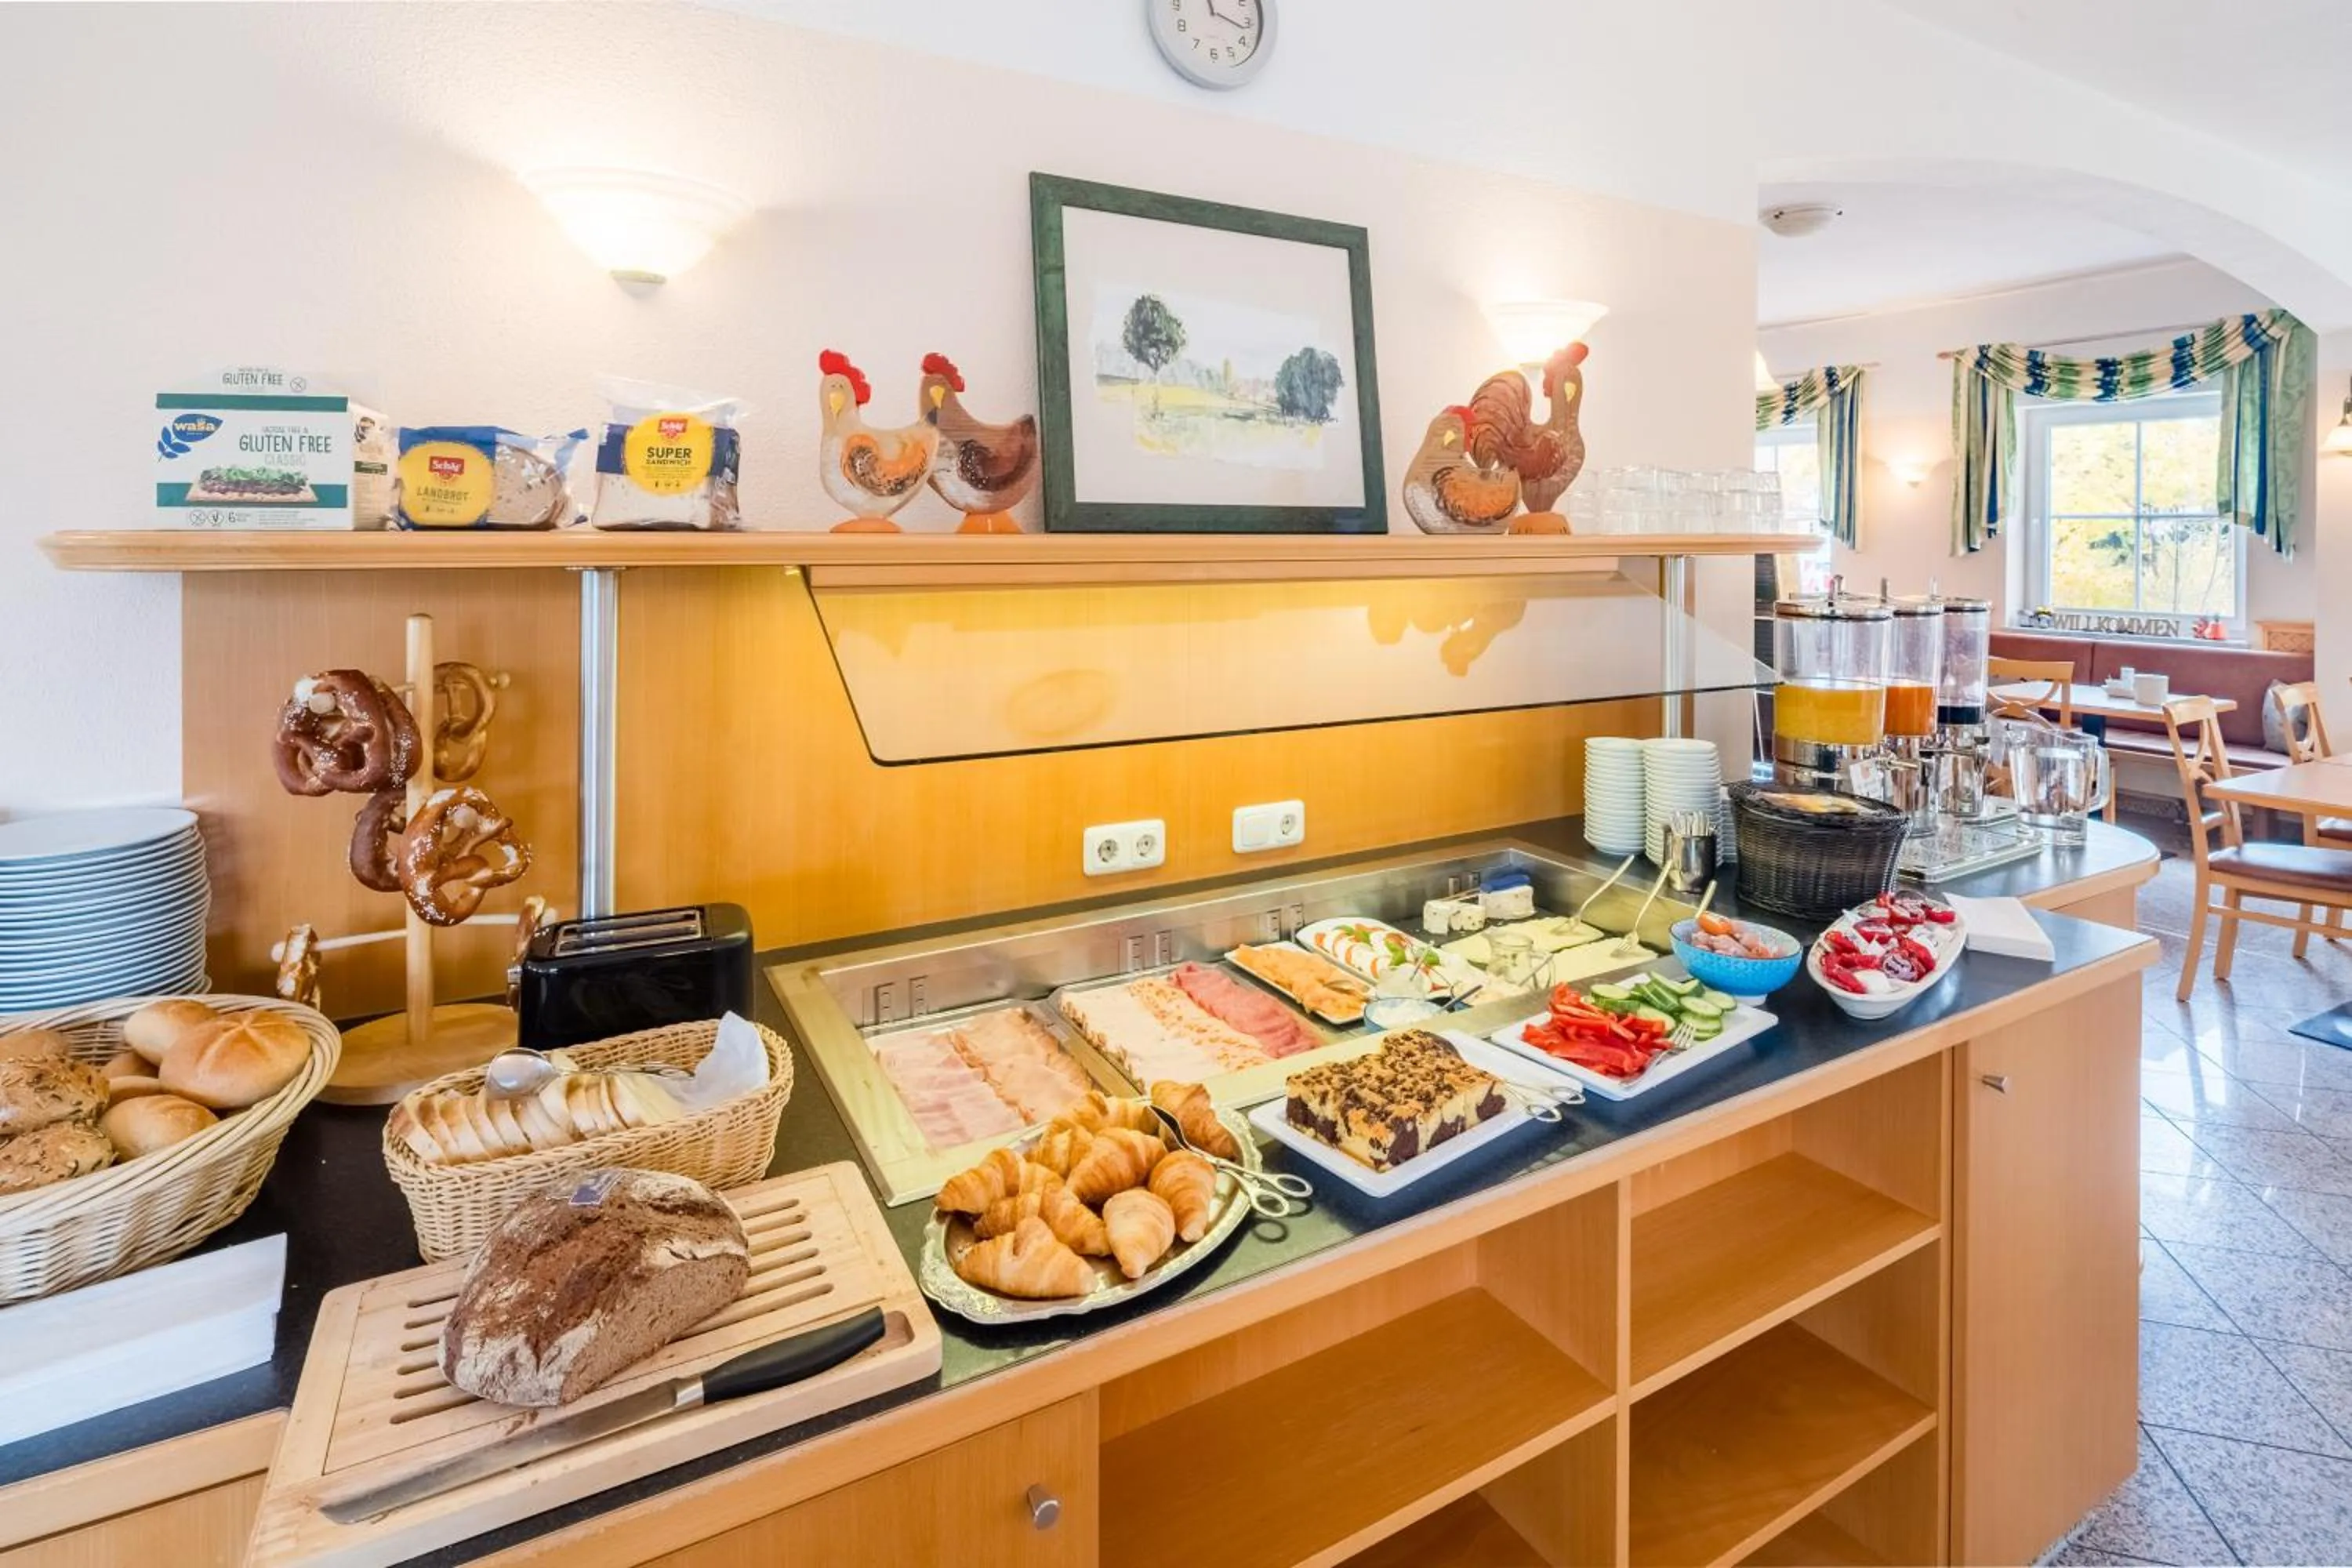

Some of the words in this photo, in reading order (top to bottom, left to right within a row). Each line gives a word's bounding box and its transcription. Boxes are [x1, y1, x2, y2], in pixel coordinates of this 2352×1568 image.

[1178, 18, 1186, 32] 8
[1192, 38, 1200, 49] 7
[1238, 35, 1246, 47] 4
[1210, 48, 1218, 60] 6
[1225, 46, 1235, 57] 5
[222, 372, 258, 385] GLUTEN
[261, 373, 283, 385] FREE
[239, 434, 292, 452] GLUTEN
[299, 435, 332, 453] FREE
[646, 446, 692, 459] SUPER
[2053, 613, 2180, 637] WILLKOMMEN
